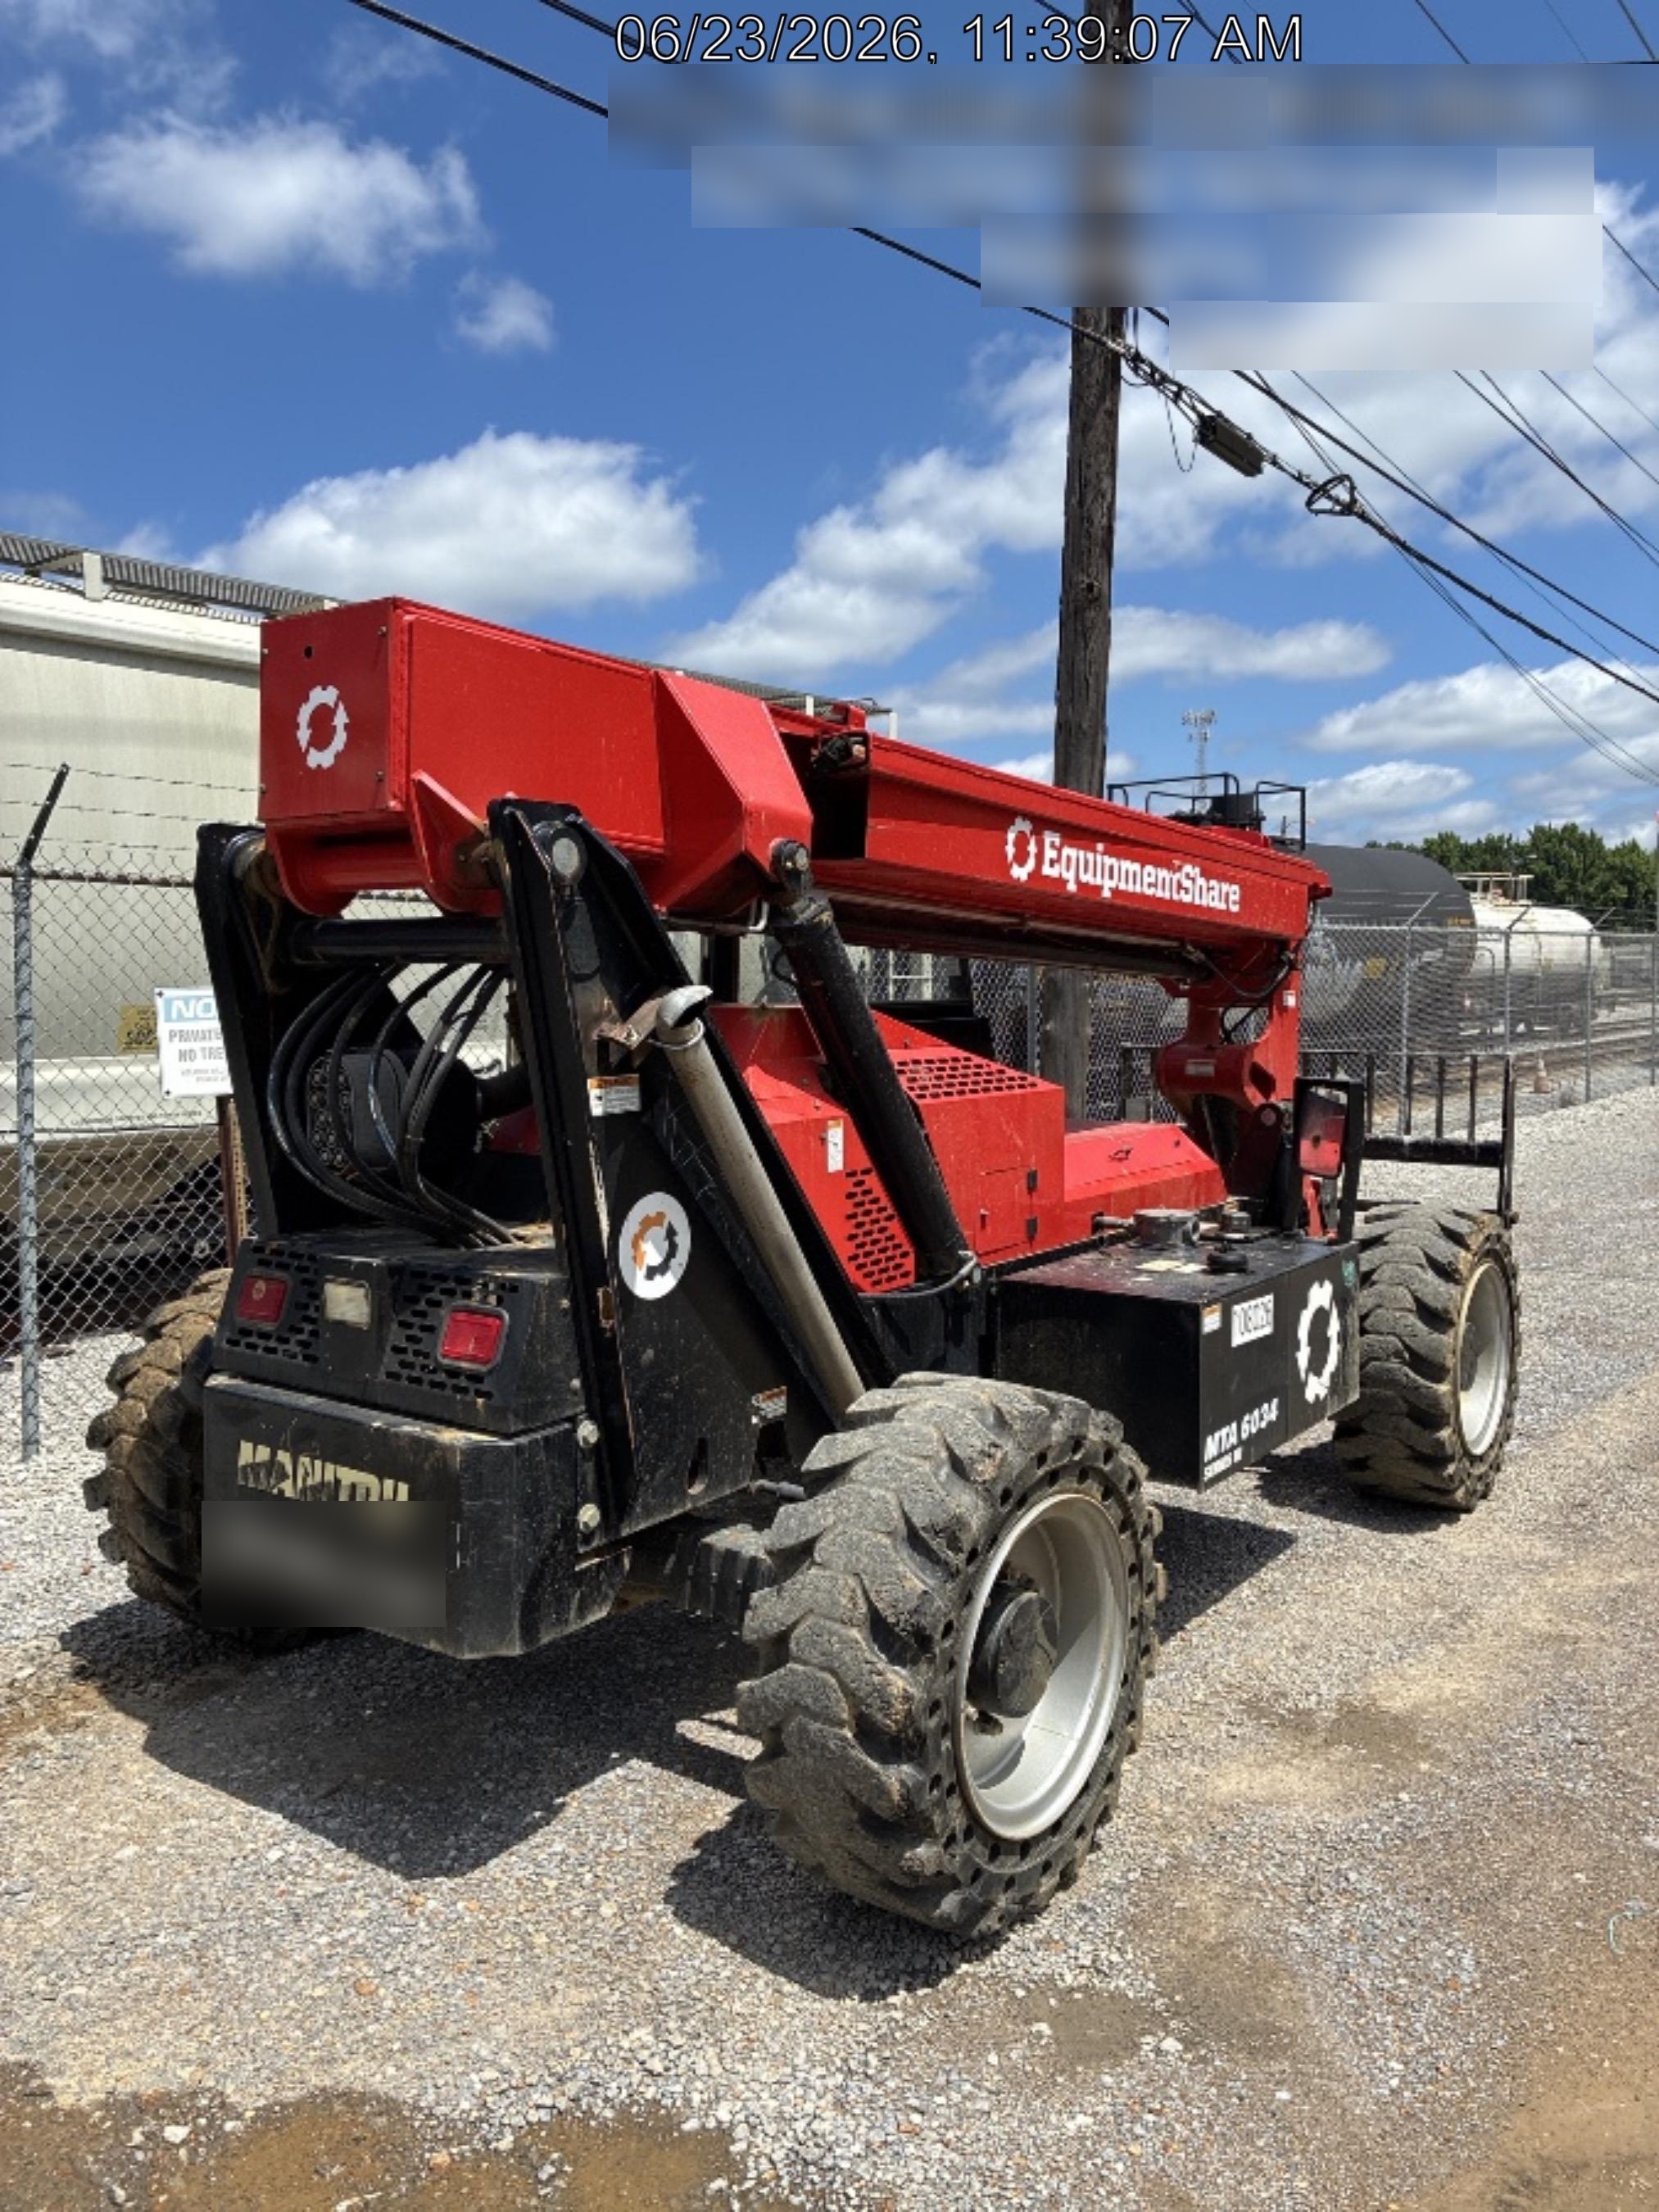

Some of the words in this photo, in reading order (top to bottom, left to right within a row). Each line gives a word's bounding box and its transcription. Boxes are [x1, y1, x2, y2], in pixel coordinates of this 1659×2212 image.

[1041, 830, 1240, 913] EquipmentShare
[179, 1049, 197, 1062] NO
[1204, 1421, 1237, 1462] MTA
[1241, 1398, 1279, 1440] 6034
